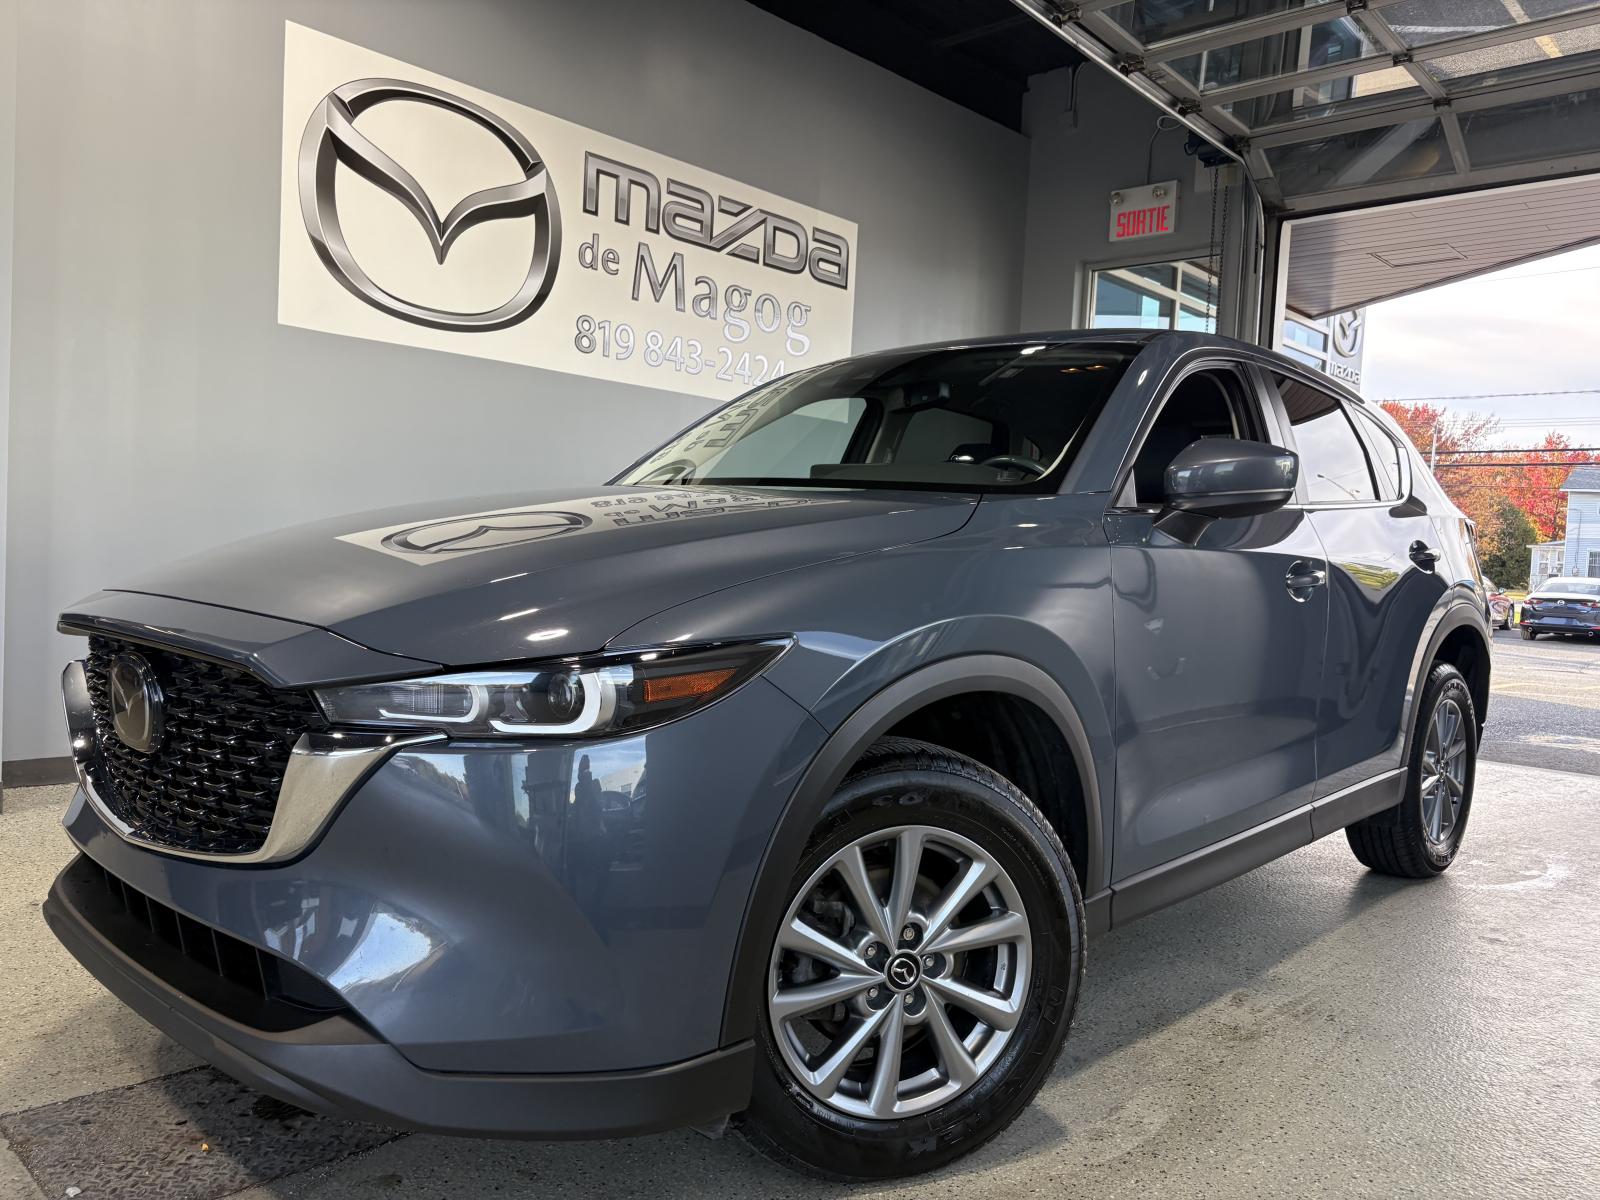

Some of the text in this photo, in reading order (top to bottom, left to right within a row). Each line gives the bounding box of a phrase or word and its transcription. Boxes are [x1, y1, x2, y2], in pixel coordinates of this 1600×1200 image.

[1116, 204, 1170, 238] SORTIE
[578, 233, 812, 356] de Magog
[574, 314, 635, 360] 819
